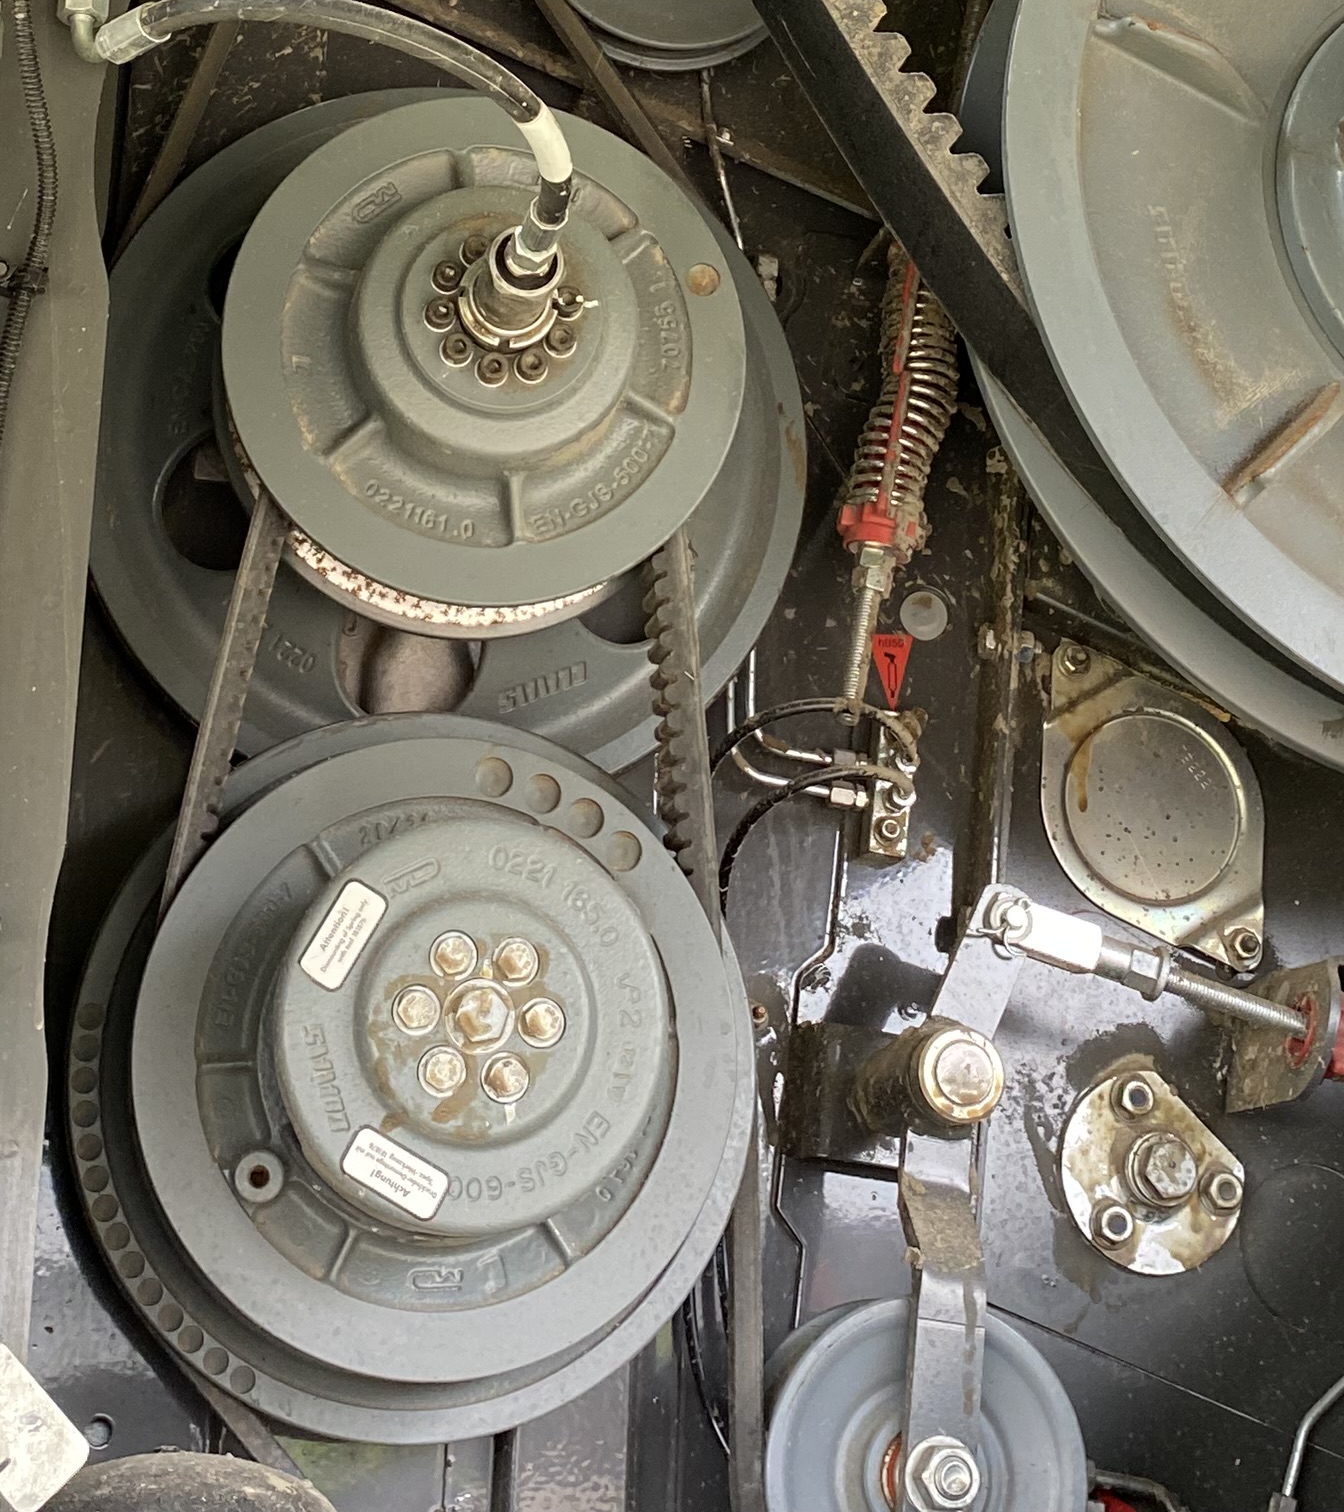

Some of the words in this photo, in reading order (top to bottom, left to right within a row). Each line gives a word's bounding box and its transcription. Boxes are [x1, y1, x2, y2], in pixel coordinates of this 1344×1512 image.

[489, 848, 560, 888] 0221
[318, 906, 350, 951] Attention!
[369, 1167, 412, 1198] Achtung!
